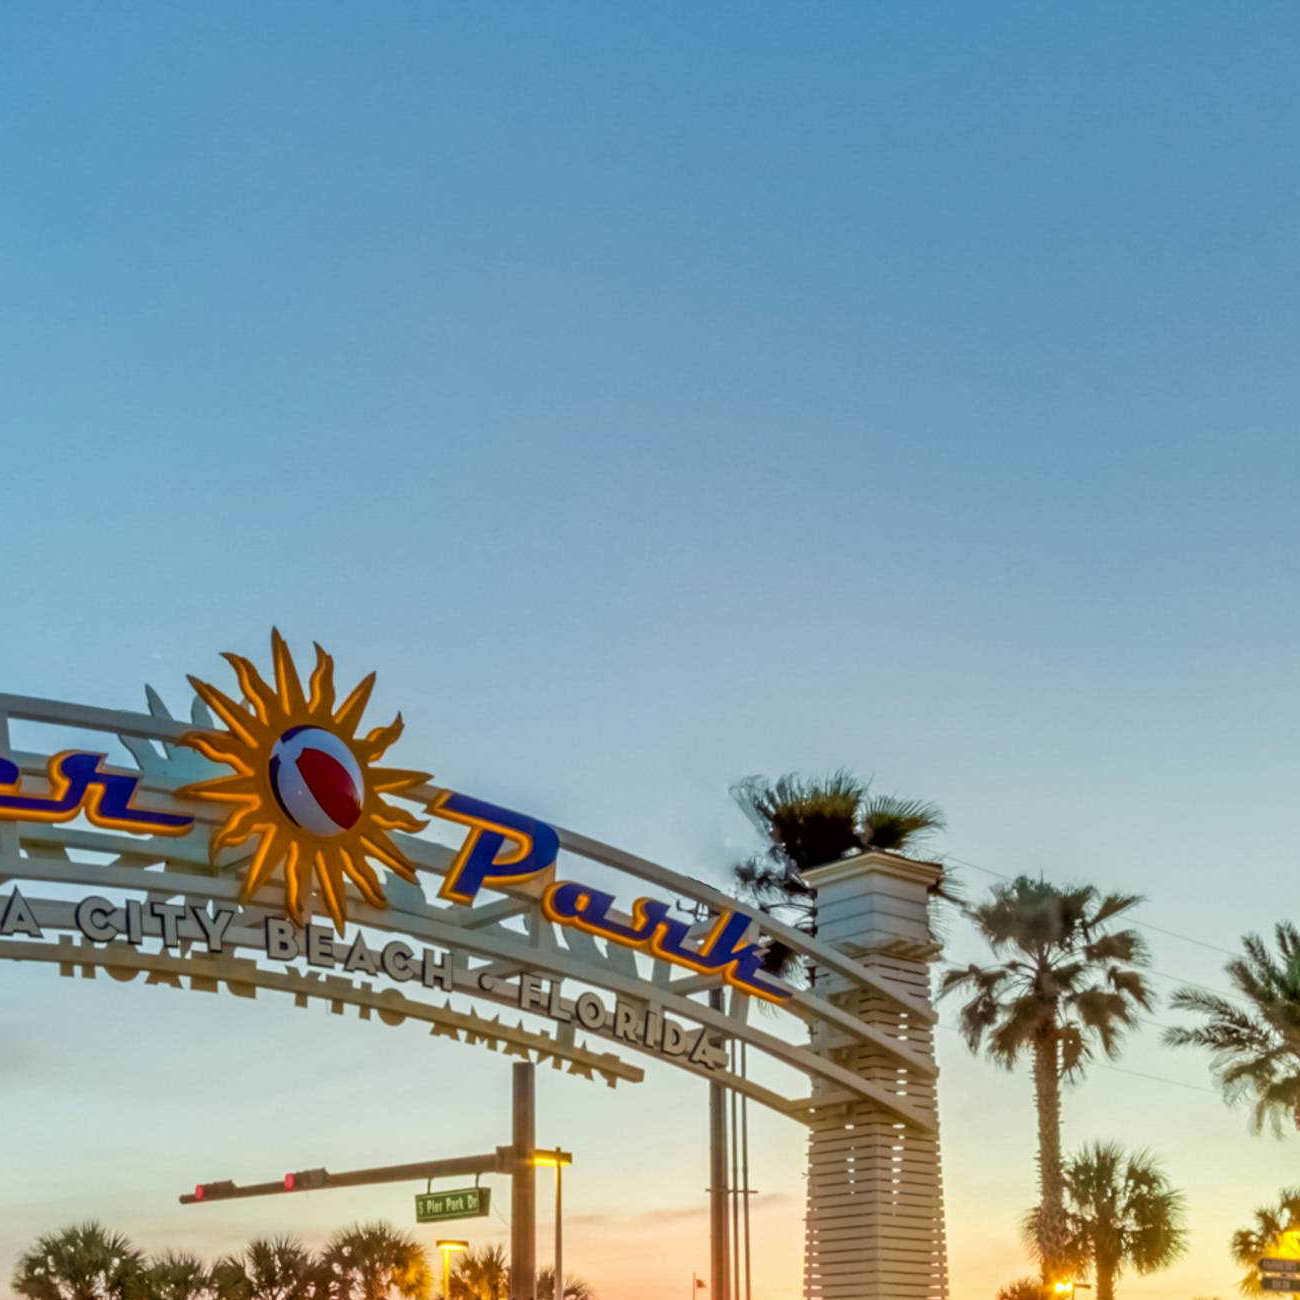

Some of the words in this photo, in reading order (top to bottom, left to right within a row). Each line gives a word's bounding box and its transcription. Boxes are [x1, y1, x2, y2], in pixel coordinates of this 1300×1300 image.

[75, 895, 234, 954] CITY
[266, 915, 453, 991] BEACH
[520, 972, 718, 1071] FLORIDA
[426, 790, 792, 1002] Park
[427, 1200, 443, 1214] Pier
[446, 1196, 465, 1211] Park
[467, 1194, 477, 1209] Dr
